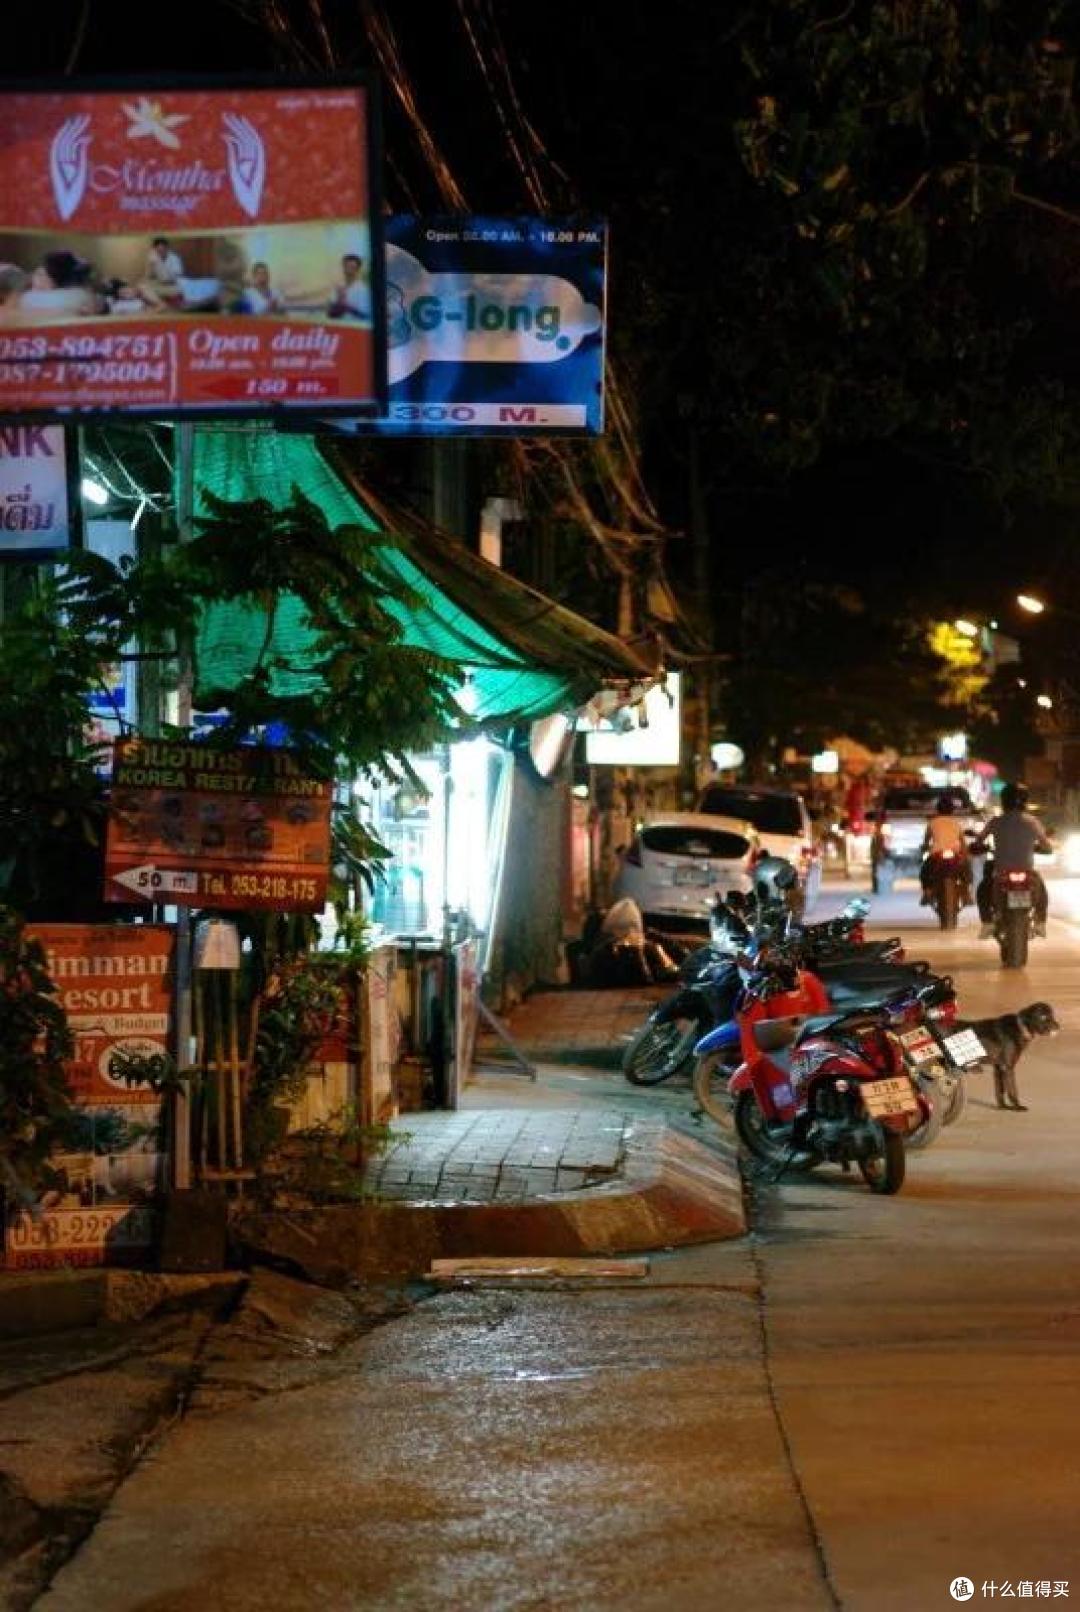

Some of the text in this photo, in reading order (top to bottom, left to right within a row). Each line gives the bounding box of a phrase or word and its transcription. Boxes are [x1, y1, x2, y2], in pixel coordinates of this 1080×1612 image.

[425, 229, 457, 242] Open
[410, 295, 560, 341] G-long
[188, 327, 340, 359] Open daily
[396, 406, 476, 423] 300
[137, 872, 162, 888] 50
[47, 948, 168, 977] imman
[54, 981, 152, 1010] esort
